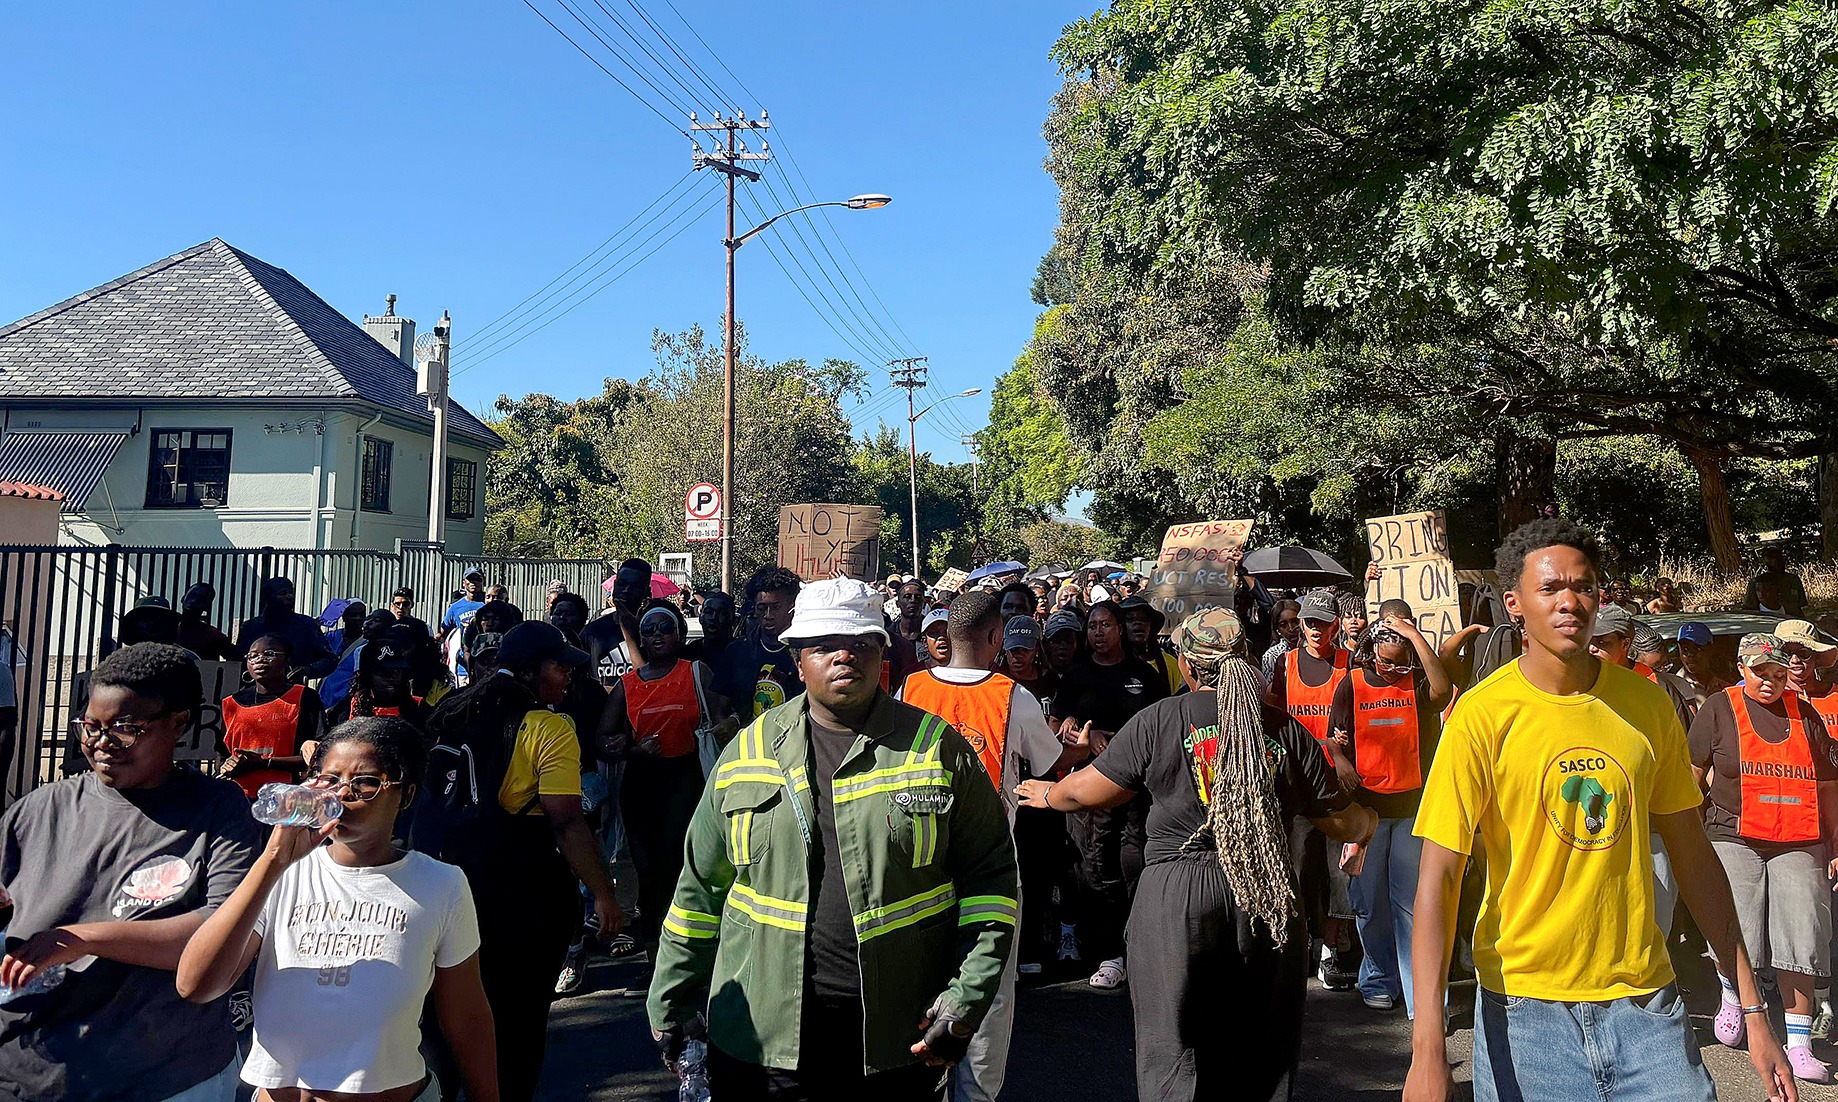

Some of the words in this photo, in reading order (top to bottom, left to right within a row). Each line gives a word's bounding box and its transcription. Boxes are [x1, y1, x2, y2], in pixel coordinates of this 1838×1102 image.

[697, 492, 712, 511] P
[788, 510, 861, 536] NOT
[1366, 516, 1448, 562] BRING
[823, 538, 880, 567] YET
[1153, 569, 1188, 585] UCT
[1370, 565, 1410, 605] IT
[1419, 564, 1450, 601] ON
[1359, 698, 1413, 711] MARSHALL
[1558, 757, 1606, 773] SASCO
[1741, 760, 1817, 780] MARSHALL
[1569, 834, 1606, 846] DEMOCRACY
